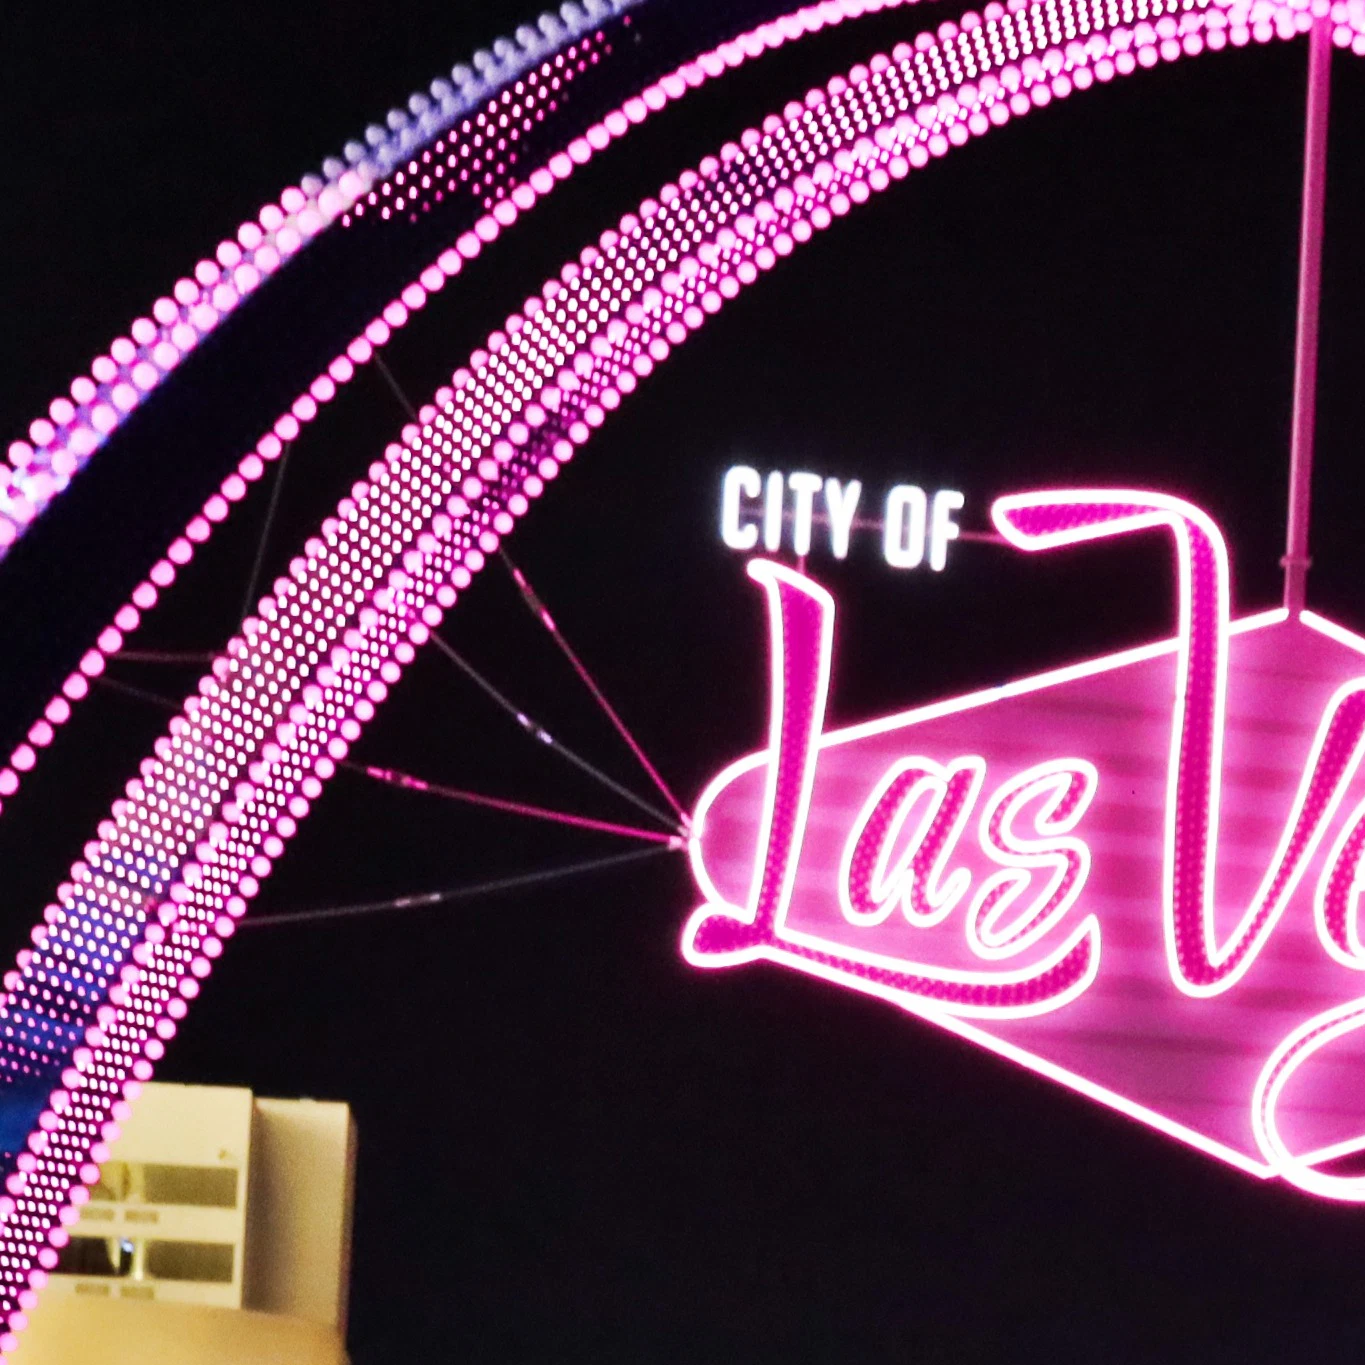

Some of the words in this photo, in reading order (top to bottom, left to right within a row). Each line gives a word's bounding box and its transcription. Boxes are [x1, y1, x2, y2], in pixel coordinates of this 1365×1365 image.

[721, 464, 863, 560] CITY
[884, 484, 965, 572] OF
[682, 556, 1101, 1020] Las
